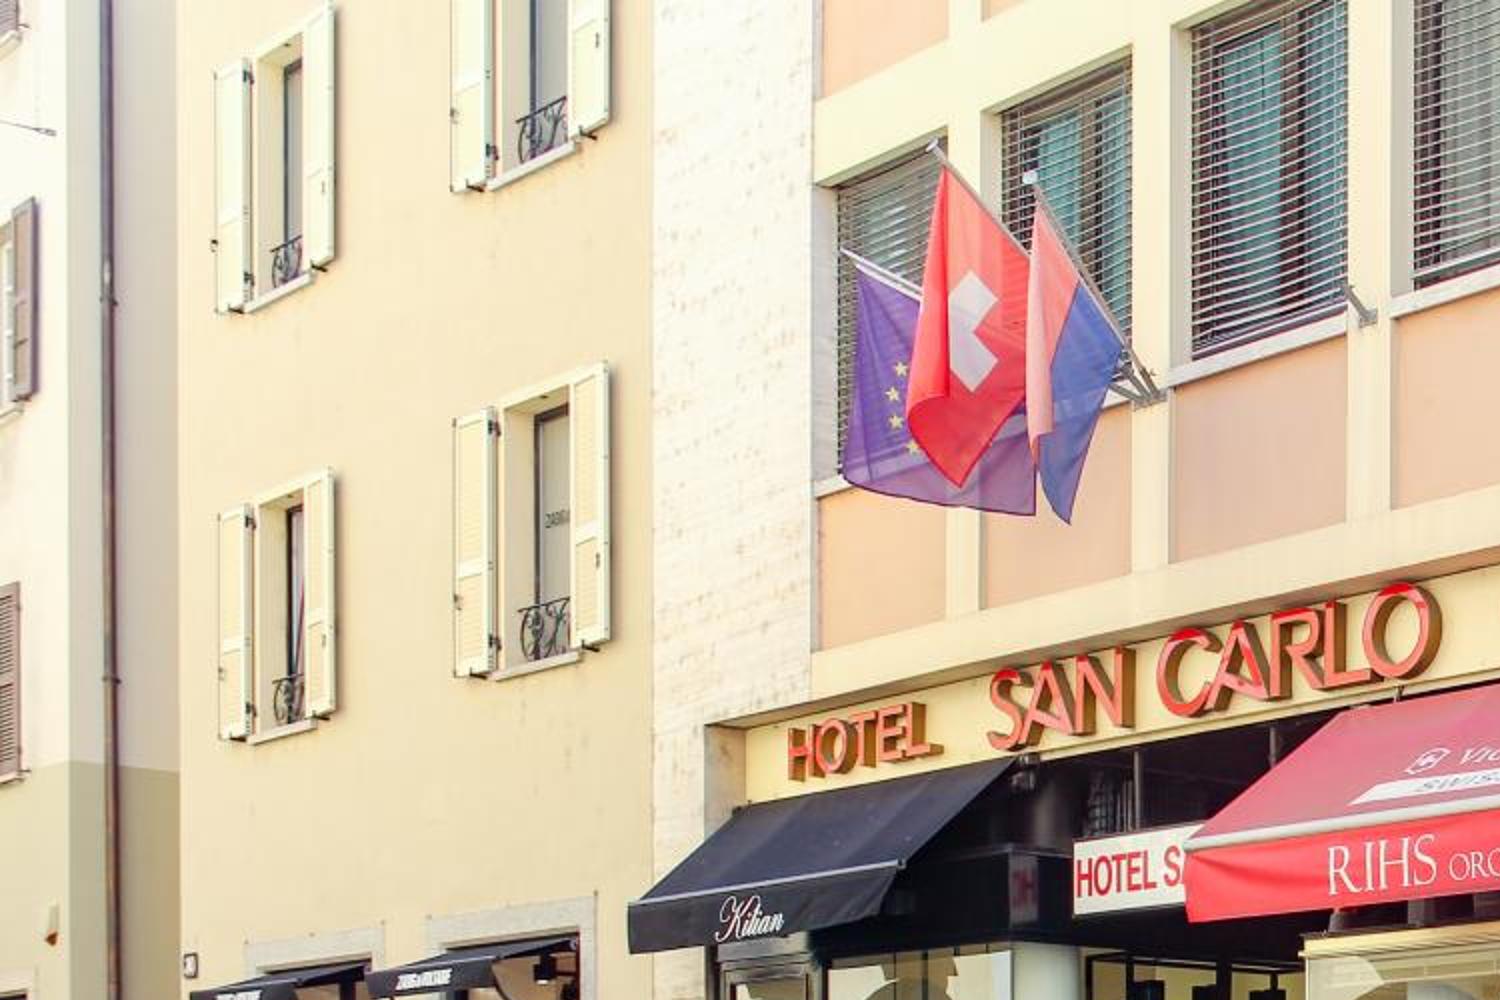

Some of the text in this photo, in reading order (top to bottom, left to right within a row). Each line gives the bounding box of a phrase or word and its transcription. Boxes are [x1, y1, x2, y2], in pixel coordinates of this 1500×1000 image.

[788, 702, 943, 782] HOTEL
[988, 646, 1136, 751] SAN
[1156, 582, 1442, 718] CARLO
[1076, 849, 1157, 898] HOTEL
[1163, 845, 1185, 887] S
[1326, 833, 1438, 896] RIHS
[715, 895, 784, 942] Kilian
